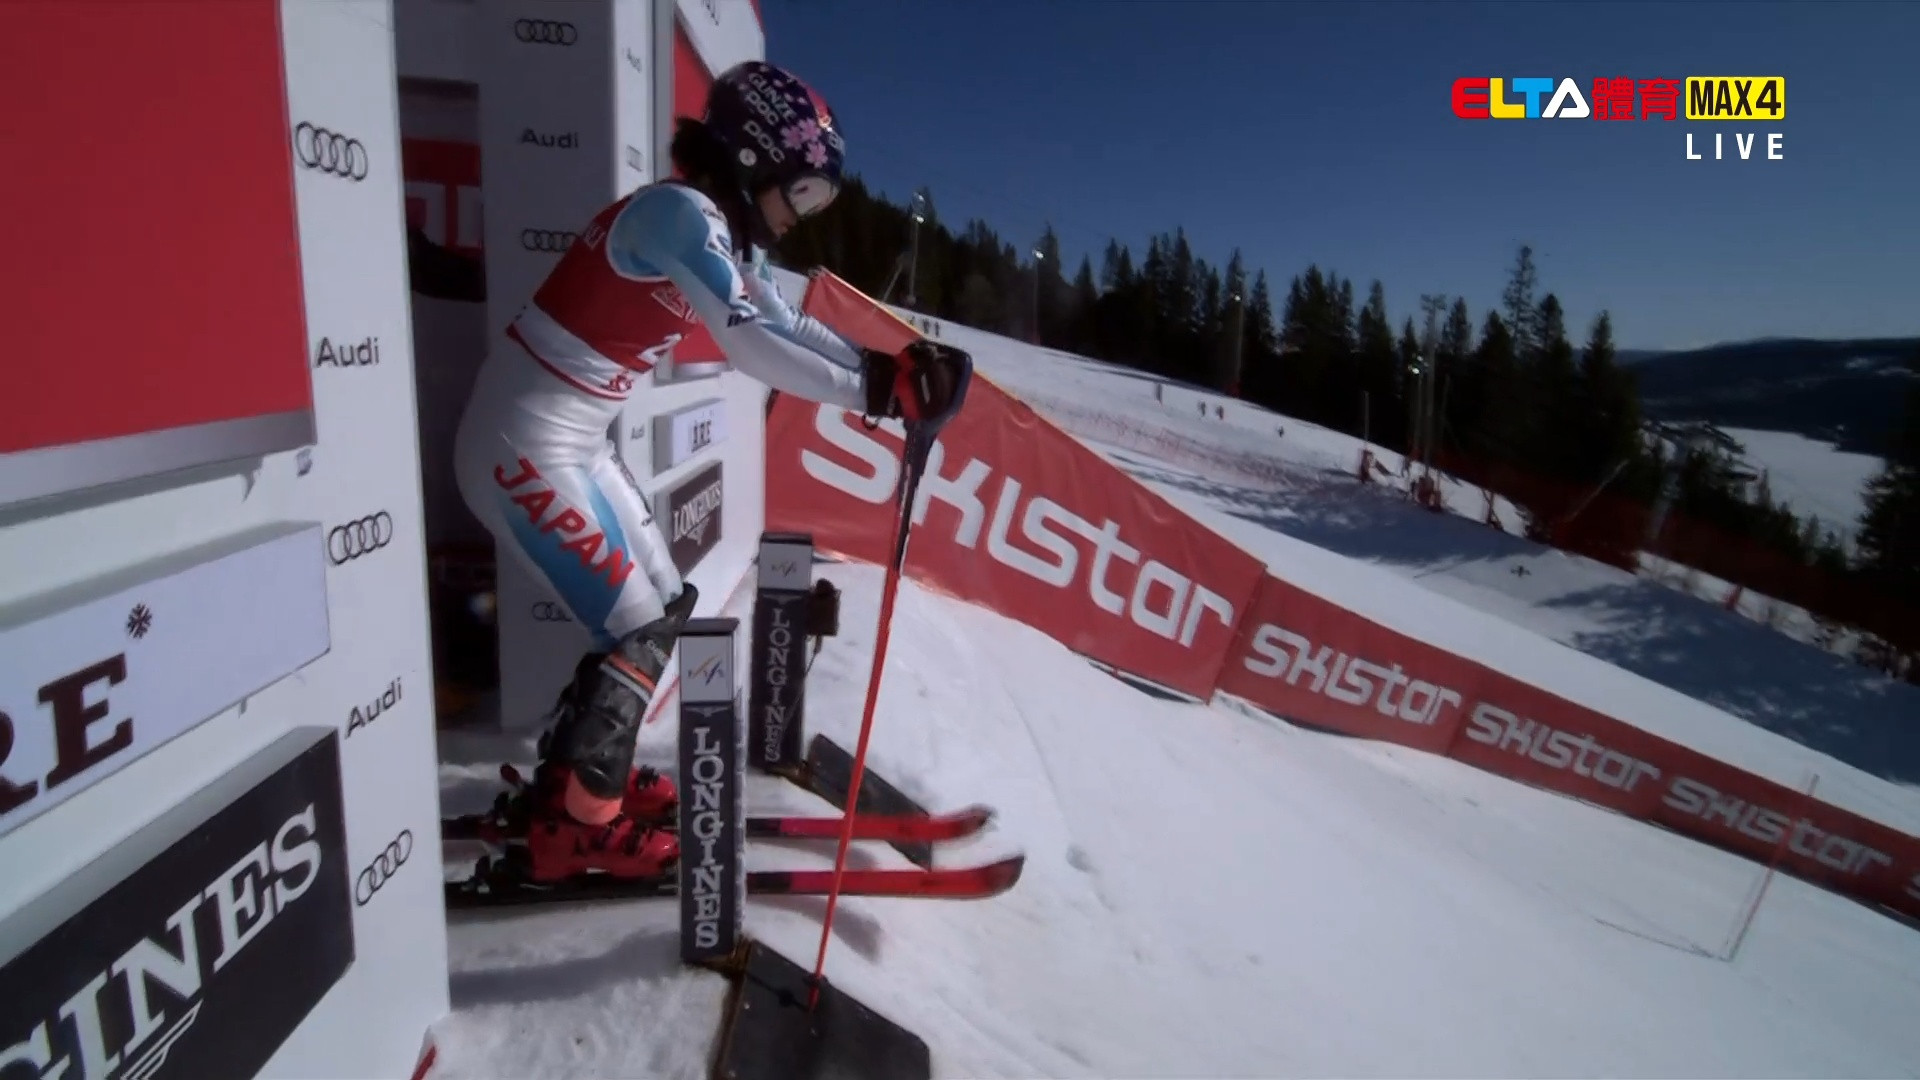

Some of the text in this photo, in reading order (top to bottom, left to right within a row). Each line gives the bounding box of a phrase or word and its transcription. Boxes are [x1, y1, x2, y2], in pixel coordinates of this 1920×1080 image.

[520, 128, 579, 150] Audi
[314, 336, 380, 369] Audi
[493, 456, 636, 590] JAPAN
[345, 676, 403, 740] Audi
[764, 607, 791, 763] LONGINES
[691, 726, 724, 949] LONGINES
